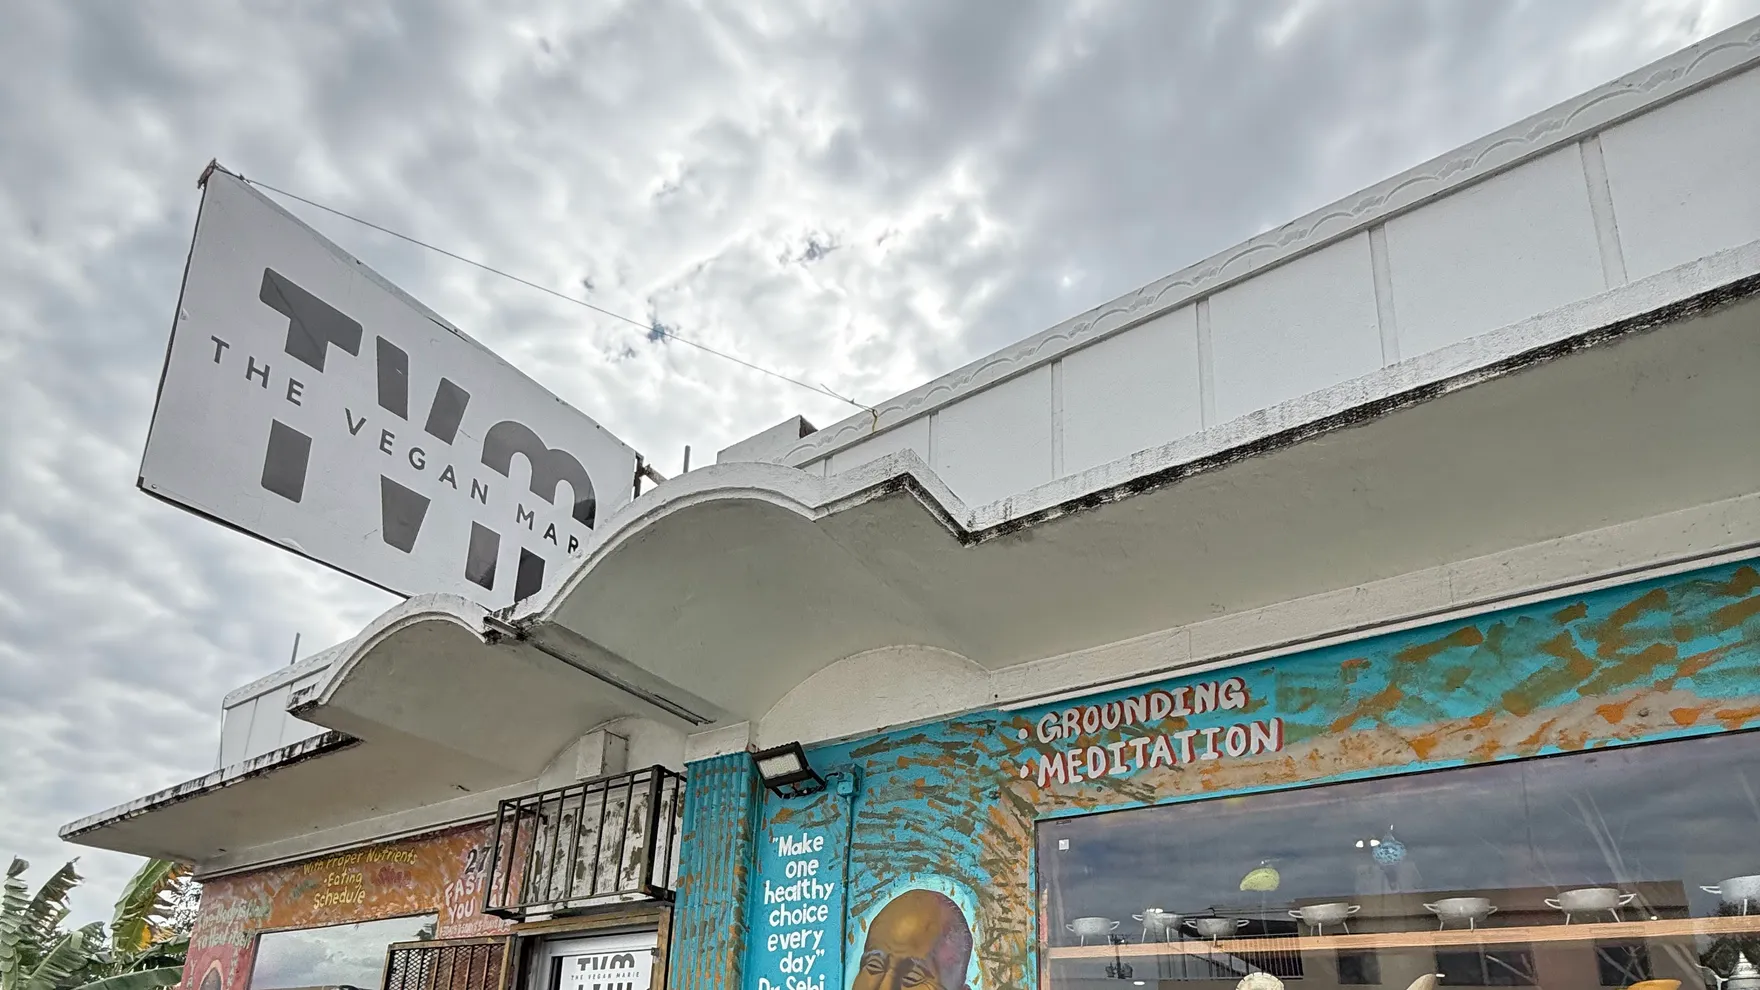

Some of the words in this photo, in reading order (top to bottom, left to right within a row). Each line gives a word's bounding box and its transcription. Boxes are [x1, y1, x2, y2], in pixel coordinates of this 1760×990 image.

[211, 335, 304, 407] THE
[344, 408, 488, 505] VEGAN
[516, 503, 579, 554] MAR
[1037, 677, 1249, 743] GROUNDING
[1038, 717, 1284, 788] MEDITATION
[304, 861, 323, 875] With
[326, 851, 364, 870] Proper
[366, 848, 418, 865] Nutrients
[785, 858, 819, 879] one
[313, 885, 366, 910] Schedule
[764, 877, 835, 904] healthy
[448, 896, 476, 924] YOU
[769, 903, 828, 927] choice
[767, 929, 824, 952] every
